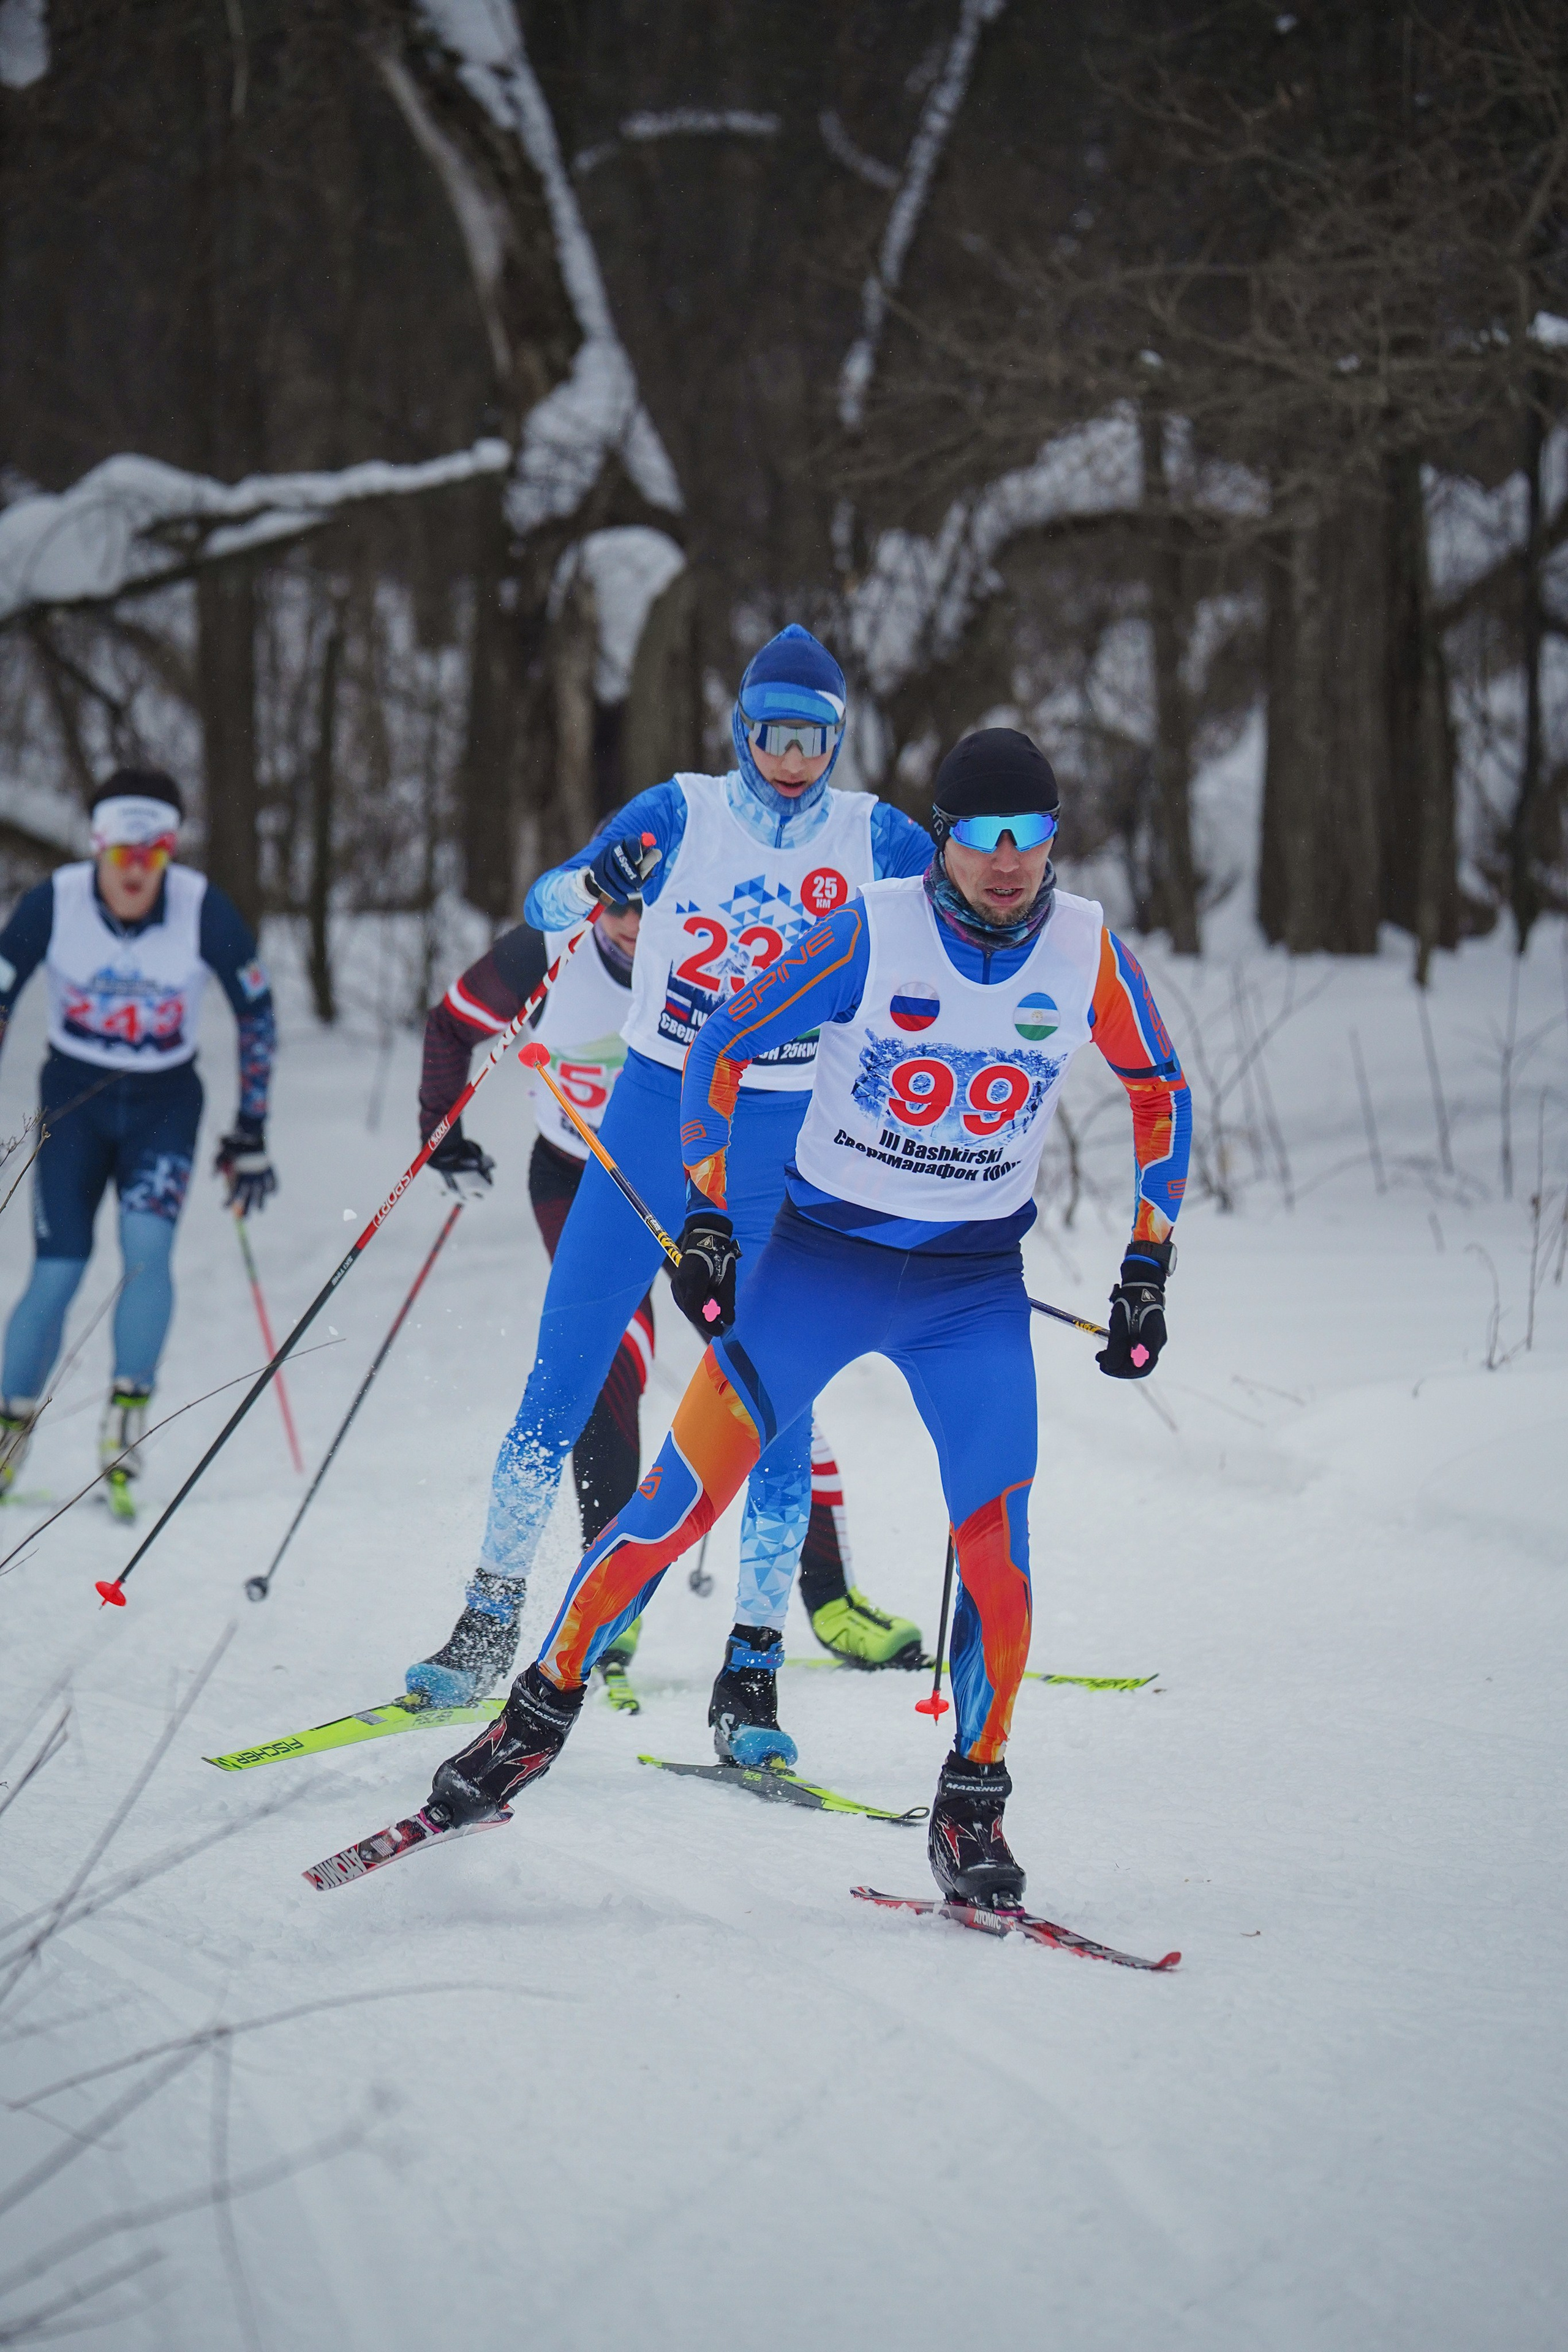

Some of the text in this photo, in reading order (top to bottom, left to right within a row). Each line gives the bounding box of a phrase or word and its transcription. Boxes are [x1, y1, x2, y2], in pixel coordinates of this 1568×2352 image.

[812, 875, 838, 899] 25
[676, 916, 783, 995] 23
[728, 925, 835, 1021] SPINE
[888, 1059, 1030, 1136] 99
[879, 1129, 900, 1151] III
[230, 1738, 304, 1765] FISCHER
[307, 1847, 368, 1890] ATOMIC
[973, 1909, 1002, 1930] ATOMIC
